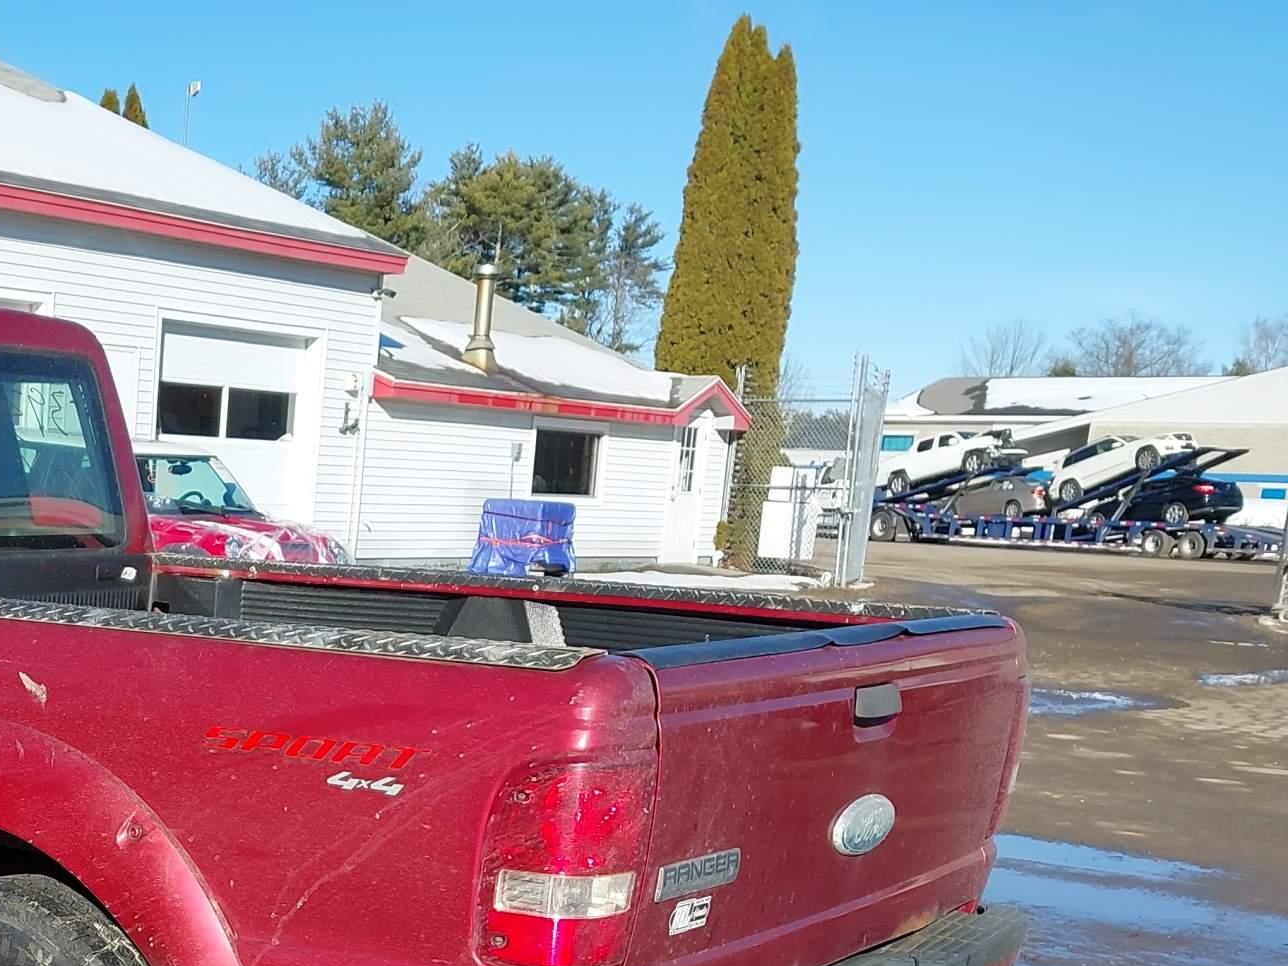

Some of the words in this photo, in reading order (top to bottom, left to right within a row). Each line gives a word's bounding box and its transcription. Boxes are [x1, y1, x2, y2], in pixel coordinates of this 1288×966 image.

[202, 725, 426, 770] SPORT
[326, 771, 405, 796] 4x4
[663, 852, 740, 888] RANGER
